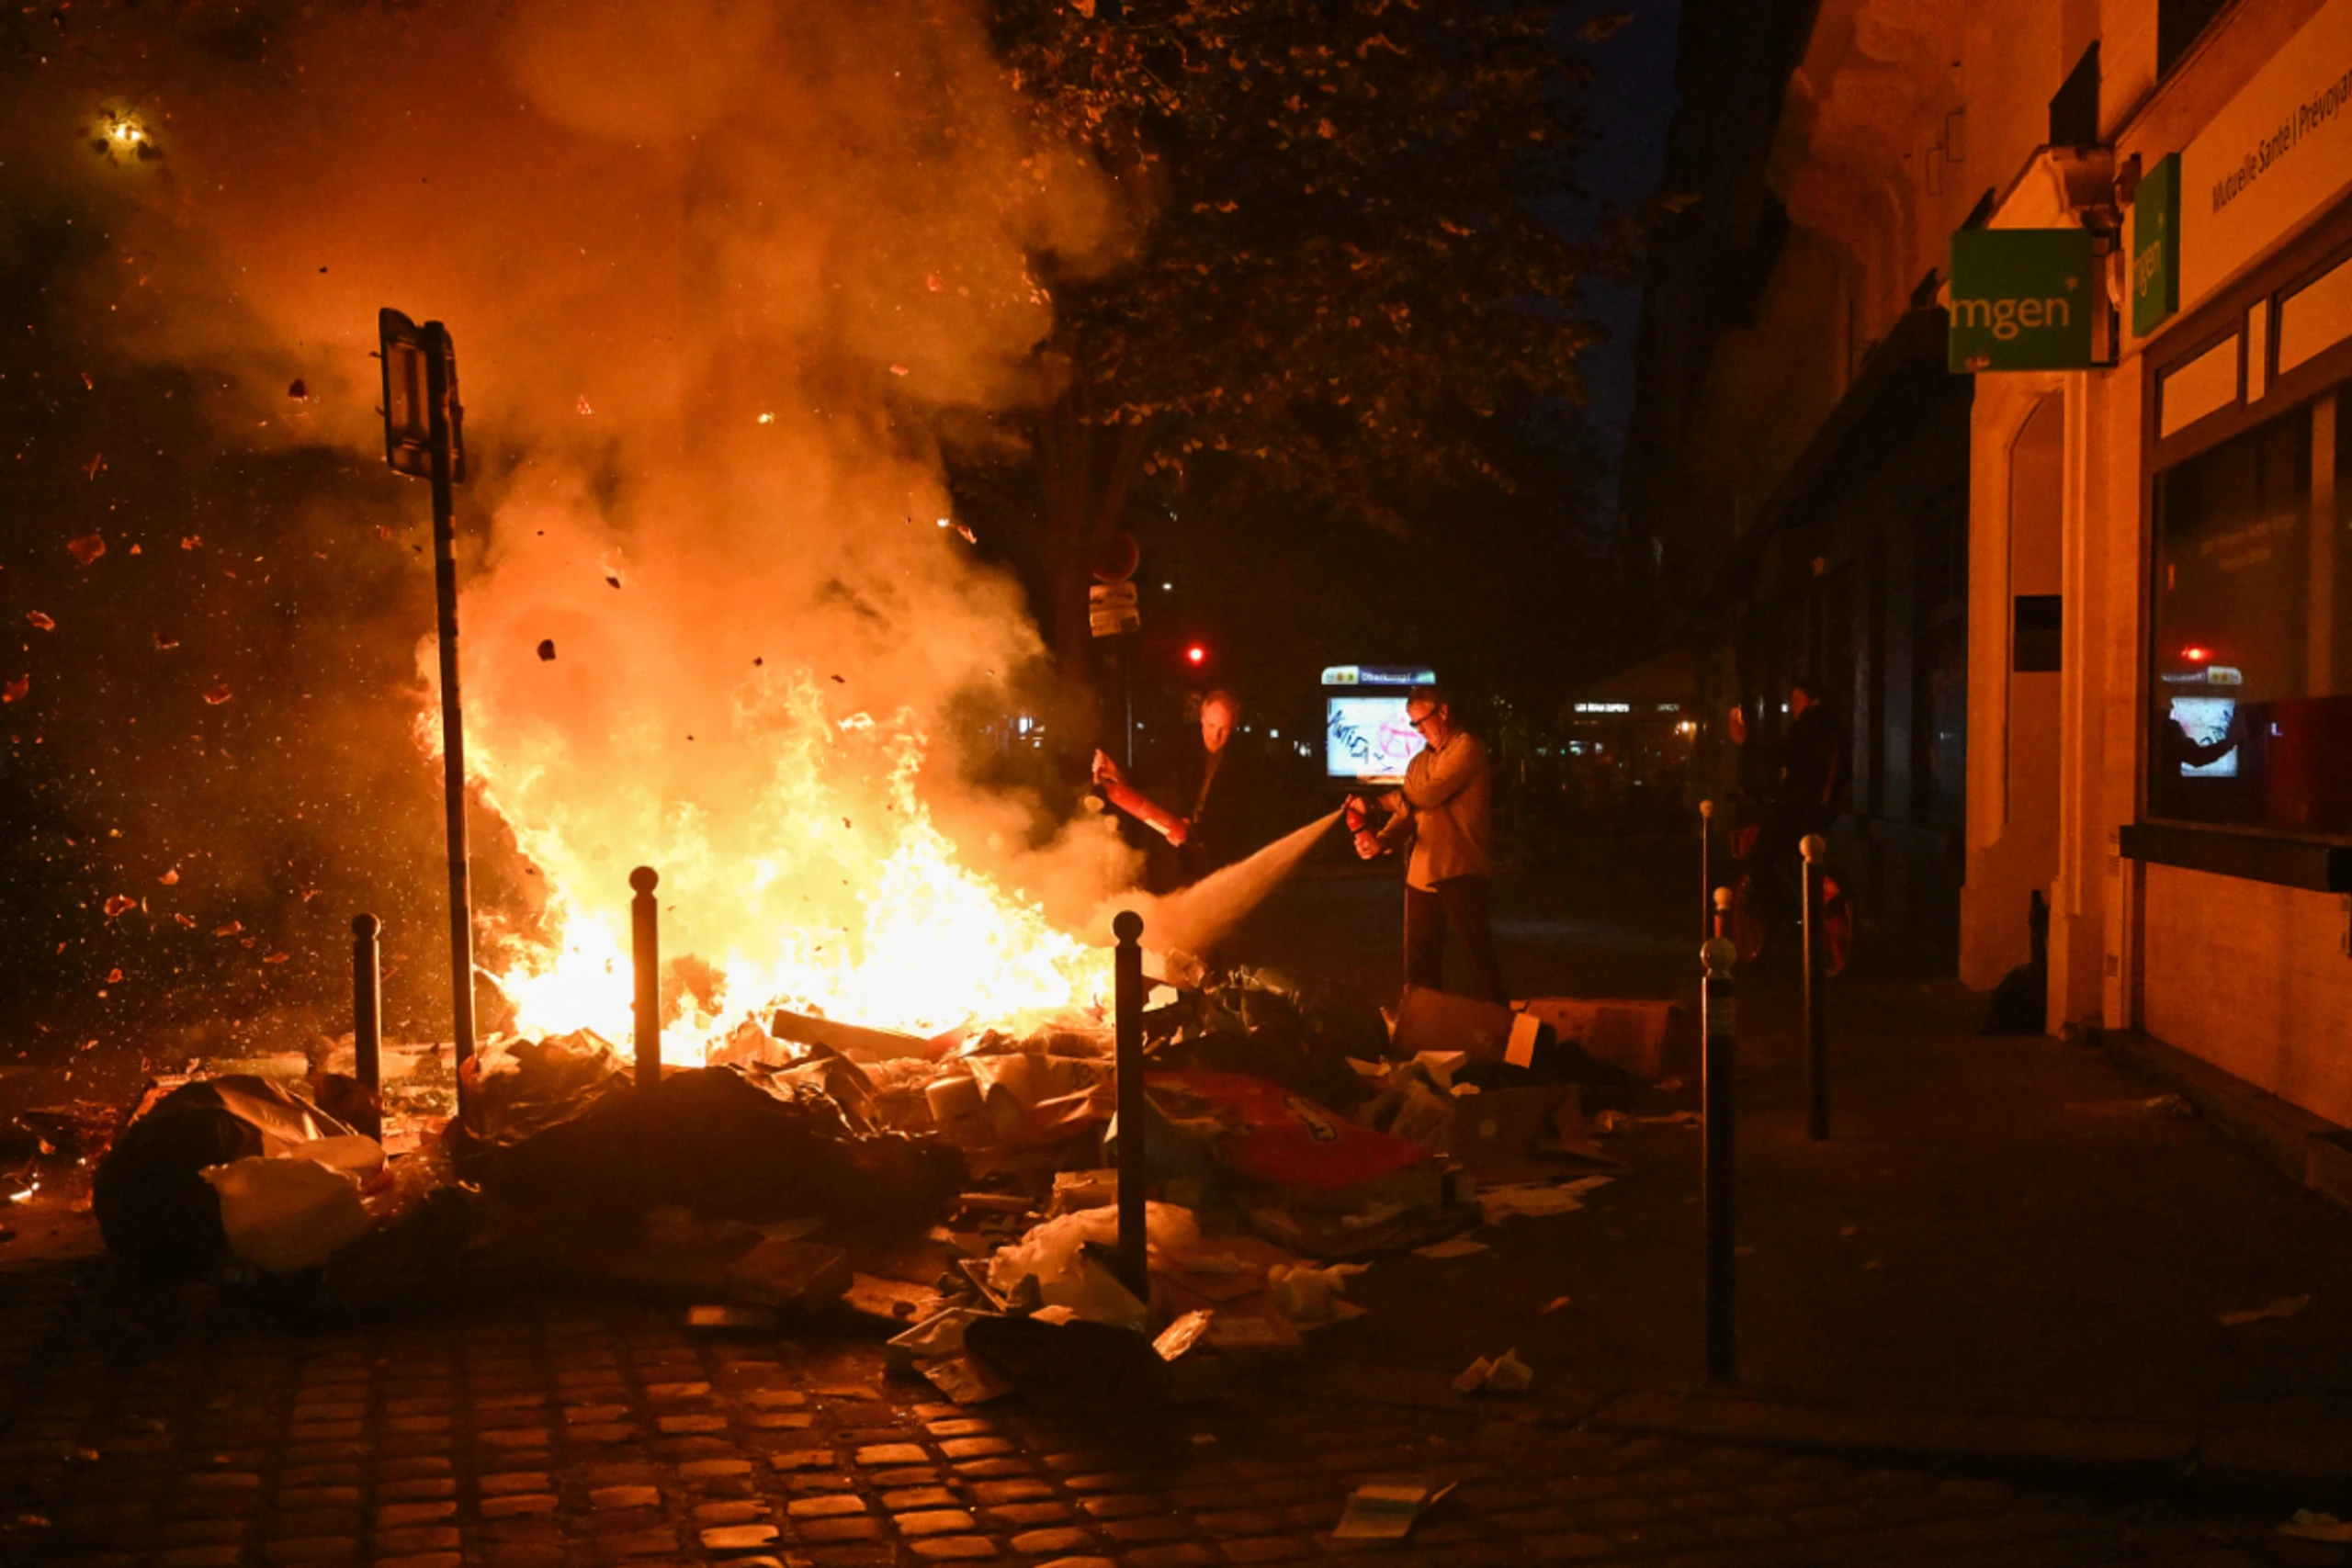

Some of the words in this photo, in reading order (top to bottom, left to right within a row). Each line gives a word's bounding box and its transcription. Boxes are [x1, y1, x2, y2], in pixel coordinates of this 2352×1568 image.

[2212, 152, 2256, 216] Mutuelle
[2258, 117, 2290, 173] Santé
[1950, 297, 2070, 341] mgen
